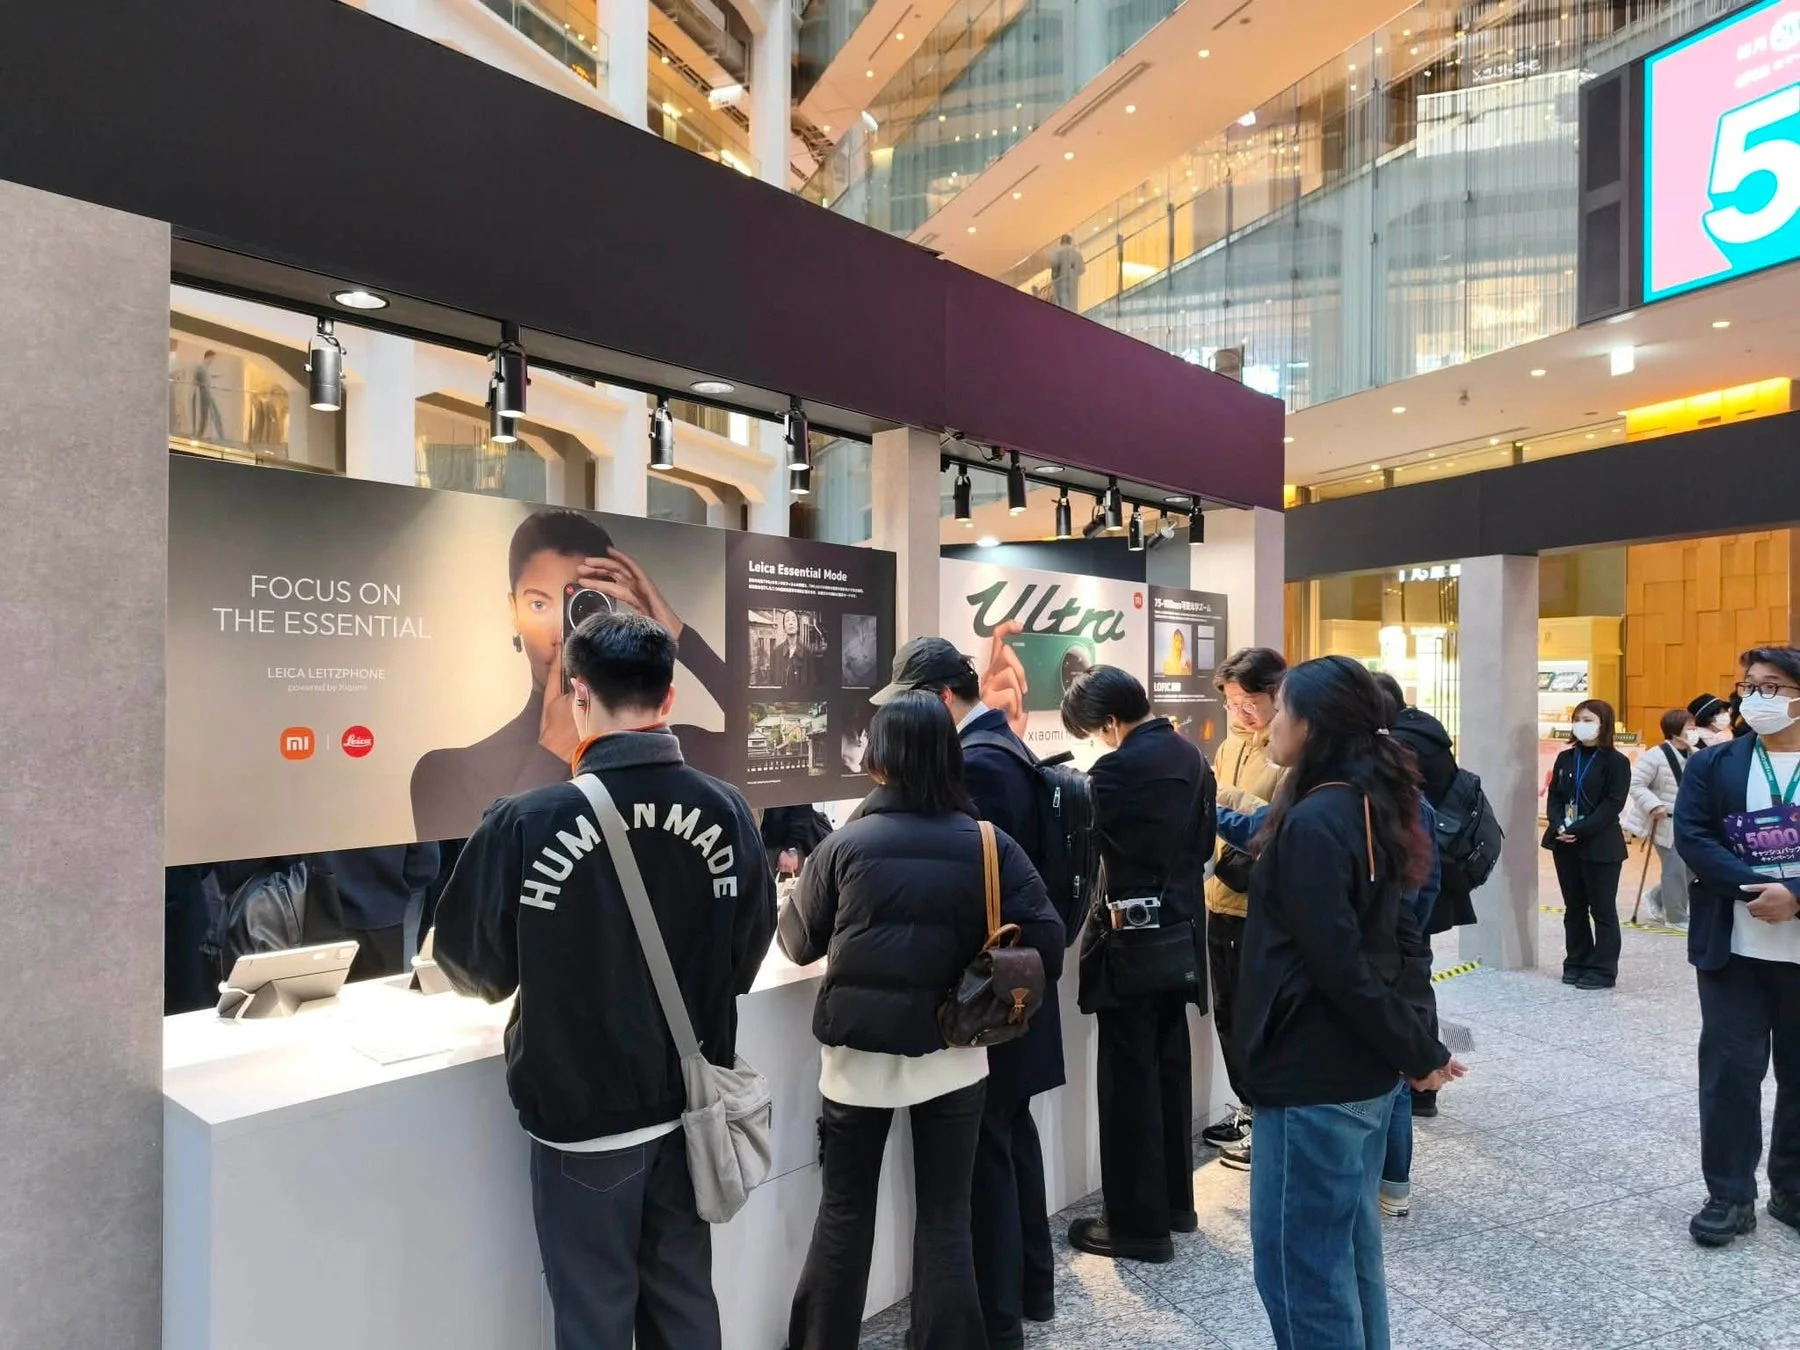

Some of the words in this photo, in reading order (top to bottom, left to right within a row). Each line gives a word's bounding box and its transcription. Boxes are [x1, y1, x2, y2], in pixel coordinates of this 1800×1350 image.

[748, 560, 776, 575] Leica
[777, 563, 822, 580] Essential
[823, 568, 848, 582] Mode
[251, 574, 352, 603] FOCUS
[359, 582, 401, 606] ON
[966, 580, 1126, 644] Ultra
[212, 607, 275, 633] THE
[284, 611, 433, 640] ESSENTIAL
[267, 667, 305, 679] LEICA
[308, 667, 386, 680] LEITZPHONE
[286, 736, 309, 751] mi
[342, 734, 372, 748] Leica
[1028, 730, 1064, 742] xiaomi
[519, 803, 656, 911] HUMN
[662, 803, 738, 899] MADE
